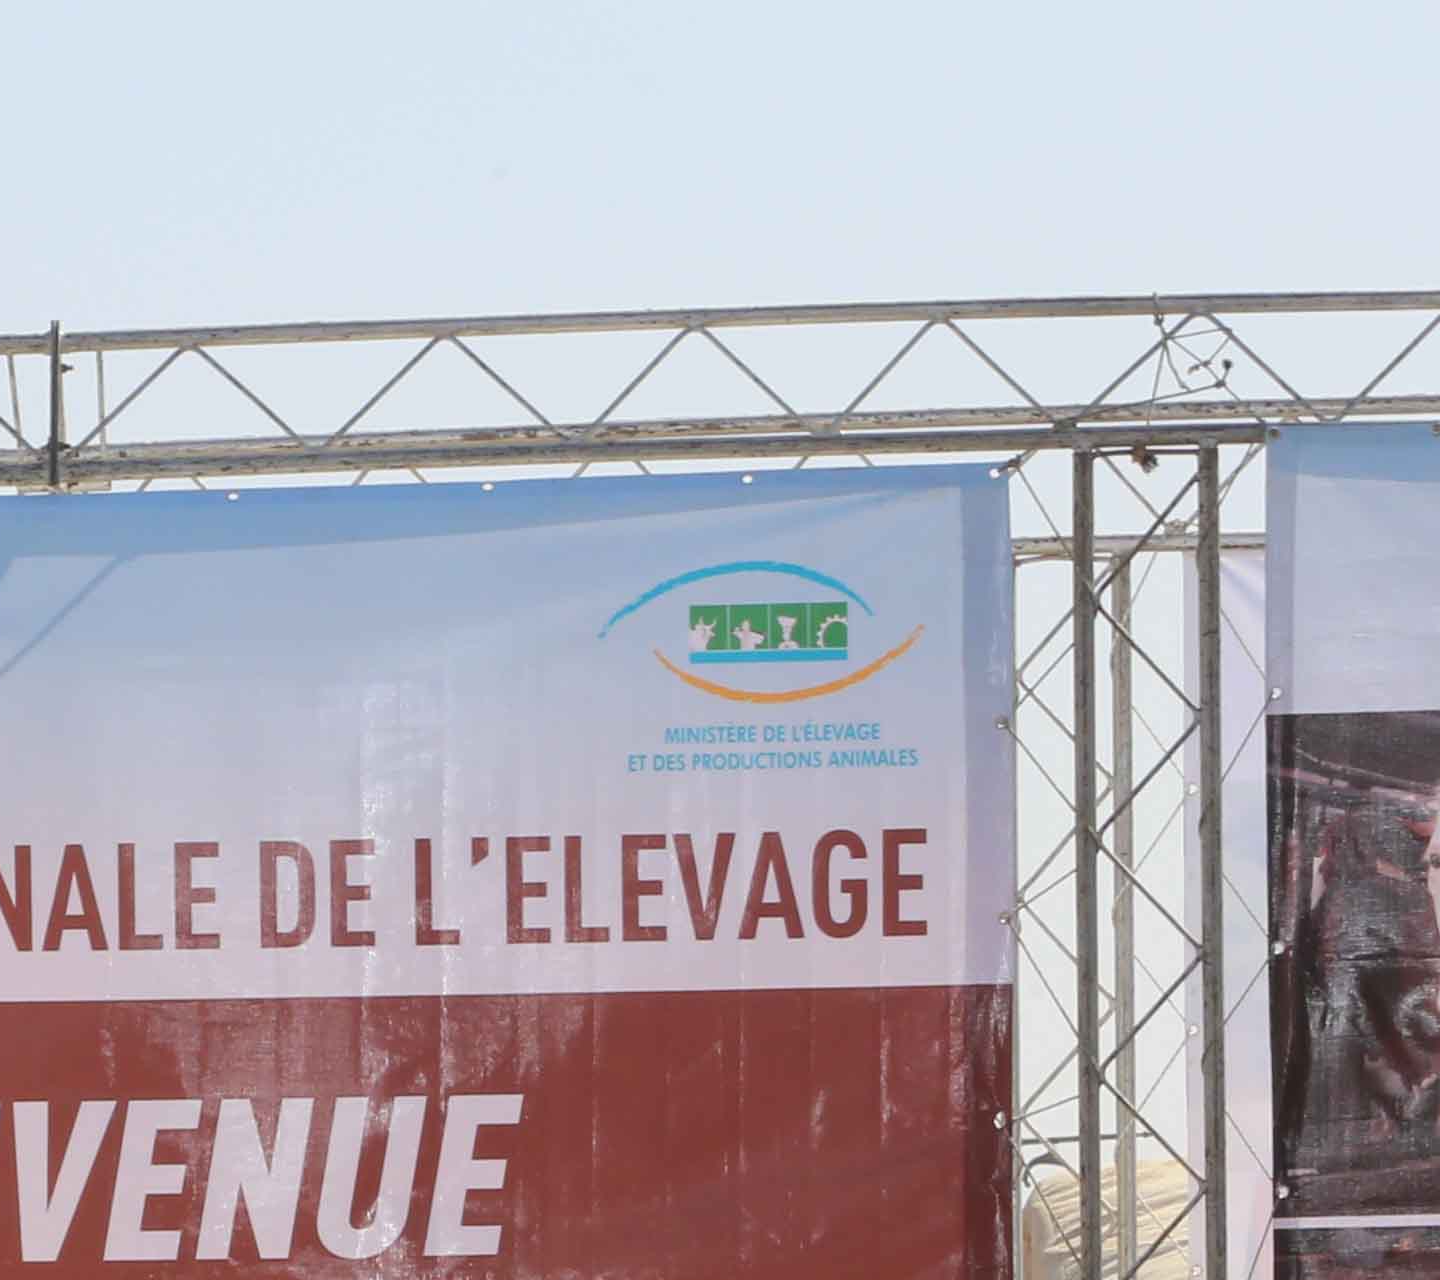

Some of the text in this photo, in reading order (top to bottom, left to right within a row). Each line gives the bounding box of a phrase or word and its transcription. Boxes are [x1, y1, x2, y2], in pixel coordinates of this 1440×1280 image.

[663, 721, 758, 744] MINISTÈRE
[763, 724, 786, 743] DE
[627, 748, 920, 772] ET DES PRODUCTIONS ANIMALES
[260, 839, 378, 951] DE
[415, 827, 929, 946] L'ELEVAGE
